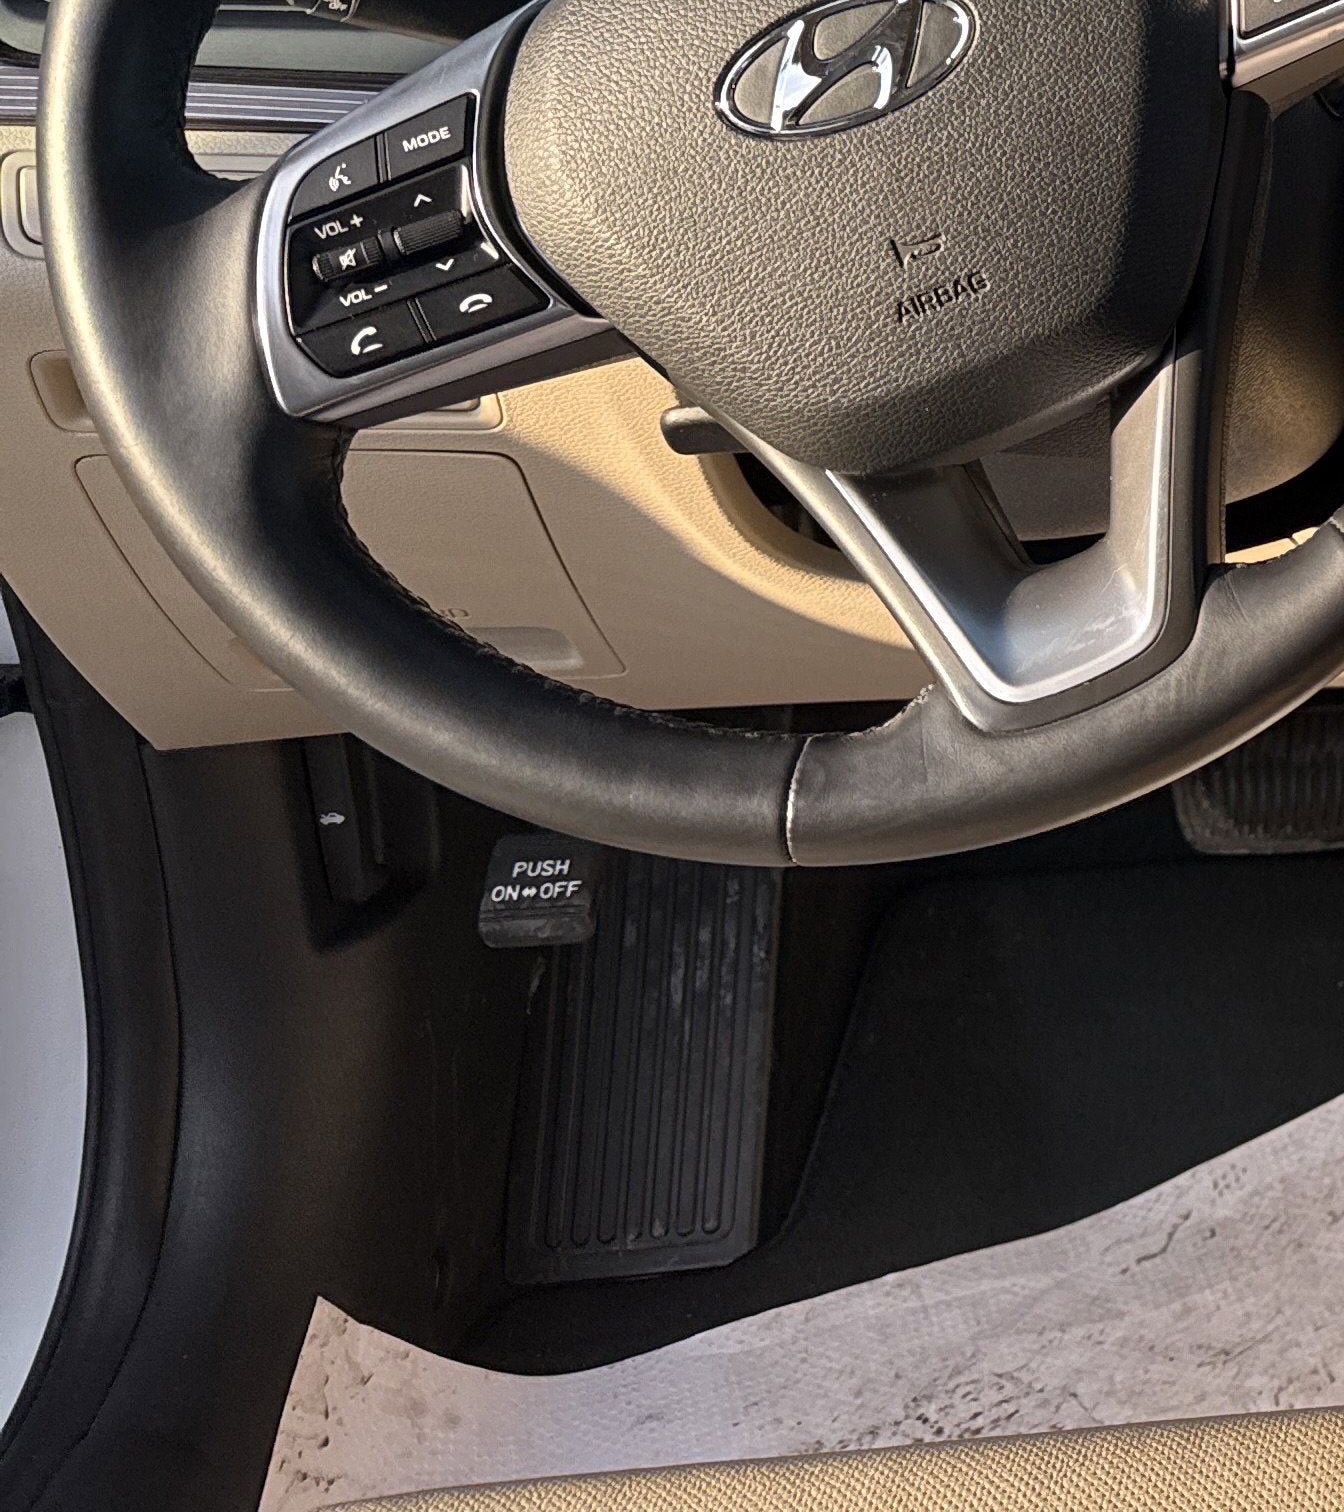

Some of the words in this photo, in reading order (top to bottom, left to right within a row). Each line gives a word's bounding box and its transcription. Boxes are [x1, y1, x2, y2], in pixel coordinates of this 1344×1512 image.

[401, 126, 452, 153] MODE
[313, 219, 350, 240] VOL
[339, 288, 373, 308] VOL
[897, 270, 991, 324] AIRBAG
[511, 858, 571, 879] PUSH
[491, 884, 521, 903] ON
[539, 879, 583, 900] OFF
